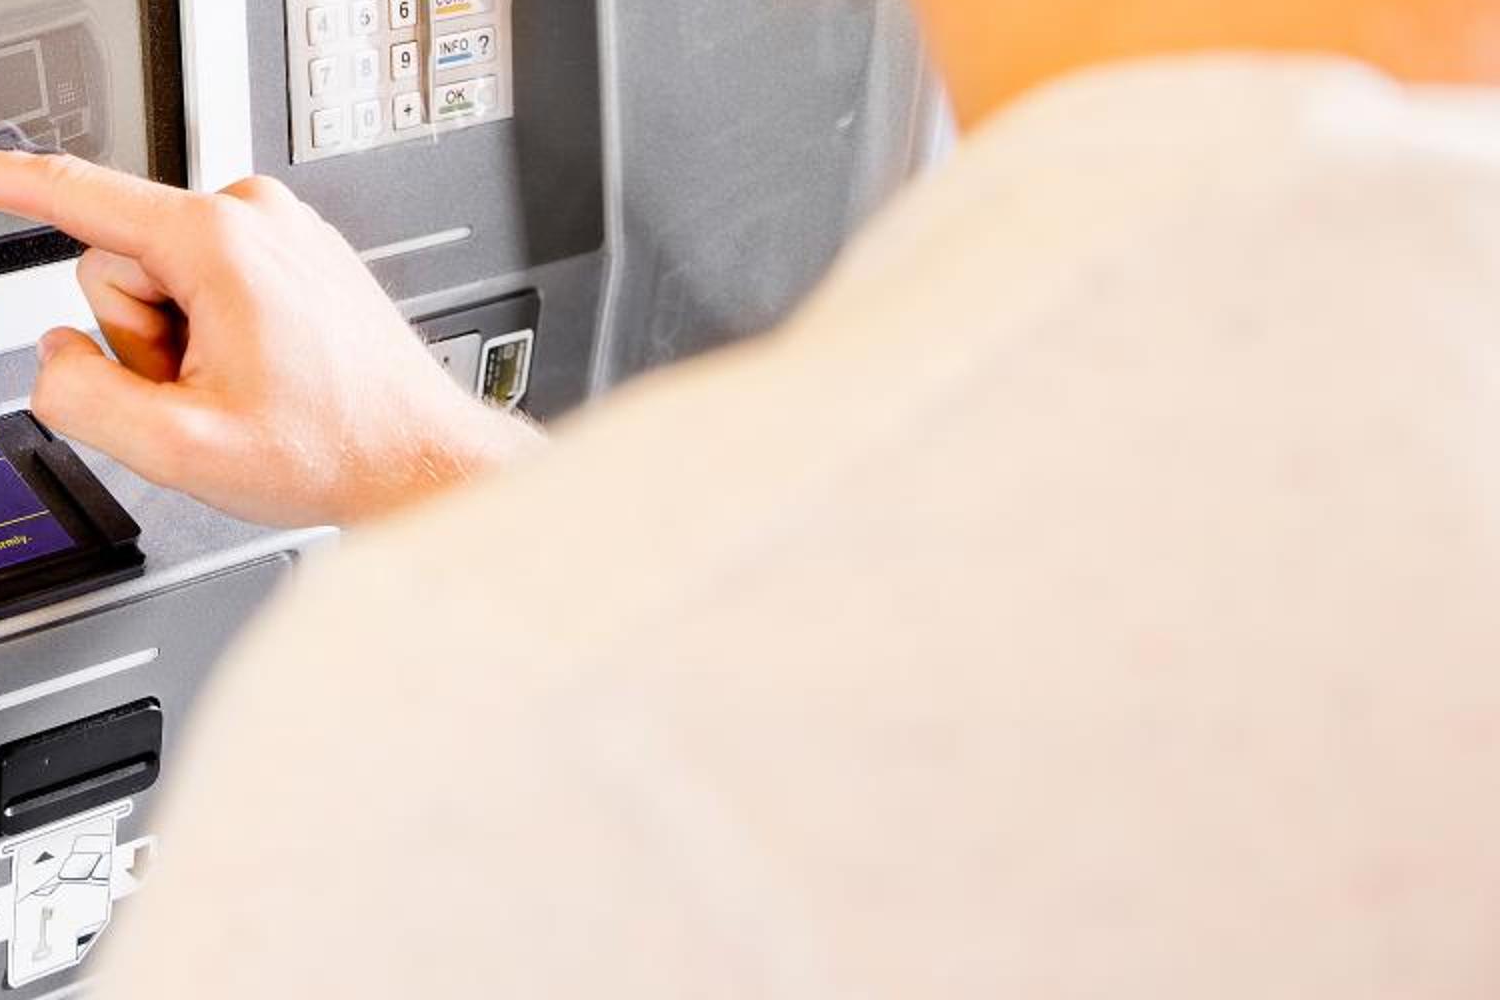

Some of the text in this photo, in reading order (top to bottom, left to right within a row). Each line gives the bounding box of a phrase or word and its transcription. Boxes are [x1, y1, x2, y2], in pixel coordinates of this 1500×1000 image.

[399, 1, 409, 19] 6
[439, 35, 490, 55] INFO ?
[400, 51, 411, 69] 9
[445, 87, 465, 105] OK
